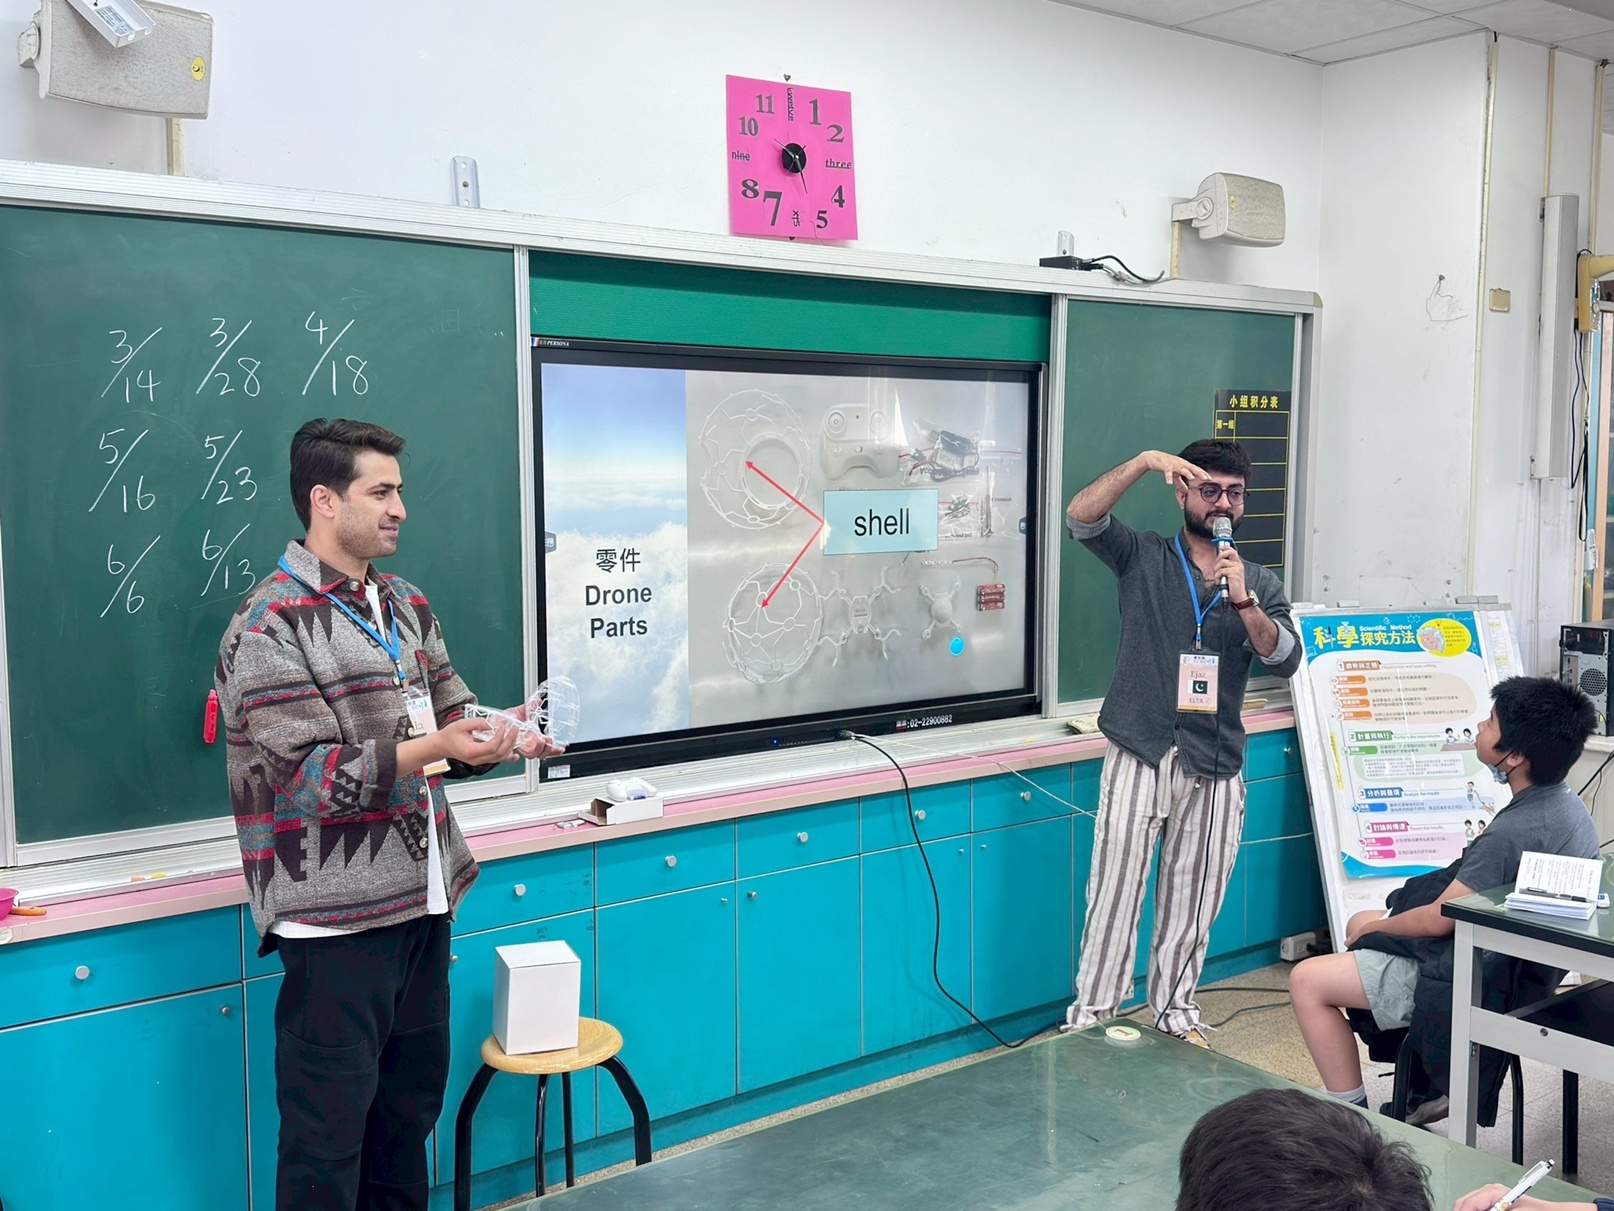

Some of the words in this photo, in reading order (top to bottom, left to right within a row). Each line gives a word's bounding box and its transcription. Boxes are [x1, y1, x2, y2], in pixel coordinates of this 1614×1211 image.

[755, 93, 775, 114] 11
[809, 98, 822, 125] 1
[738, 116, 759, 136] 10
[827, 124, 845, 143] 2
[731, 150, 751, 161] nine
[825, 158, 852, 170] three
[741, 178, 760, 199] 8
[831, 185, 845, 208] 4
[763, 190, 783, 227] 7
[791, 210, 800, 227] six
[816, 209, 829, 229] 5
[1229, 394, 1279, 409] 小组积分表
[854, 507, 910, 537] shell
[596, 547, 642, 573] 零件
[585, 584, 653, 607] Drone
[590, 616, 649, 639] Parts
